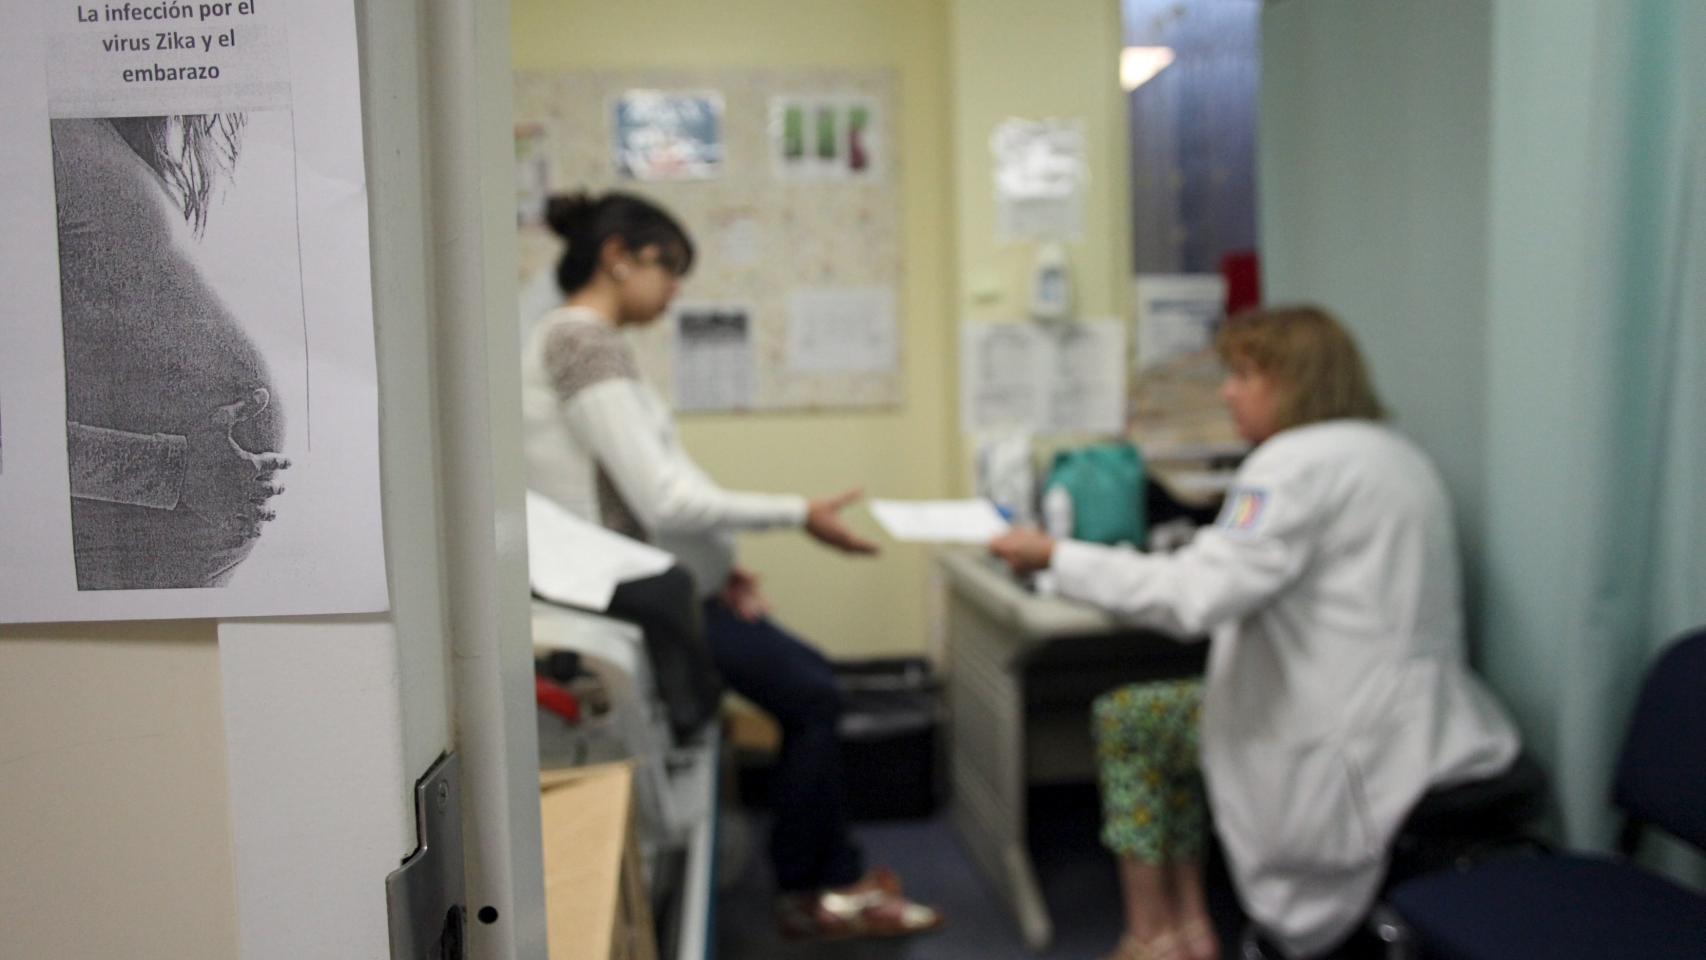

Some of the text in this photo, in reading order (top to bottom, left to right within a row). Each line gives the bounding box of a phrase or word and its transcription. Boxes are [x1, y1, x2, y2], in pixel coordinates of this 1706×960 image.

[77, 0, 255, 23] La infección por el
[102, 28, 236, 53] virus Zika y el
[122, 62, 220, 83] embarazo
